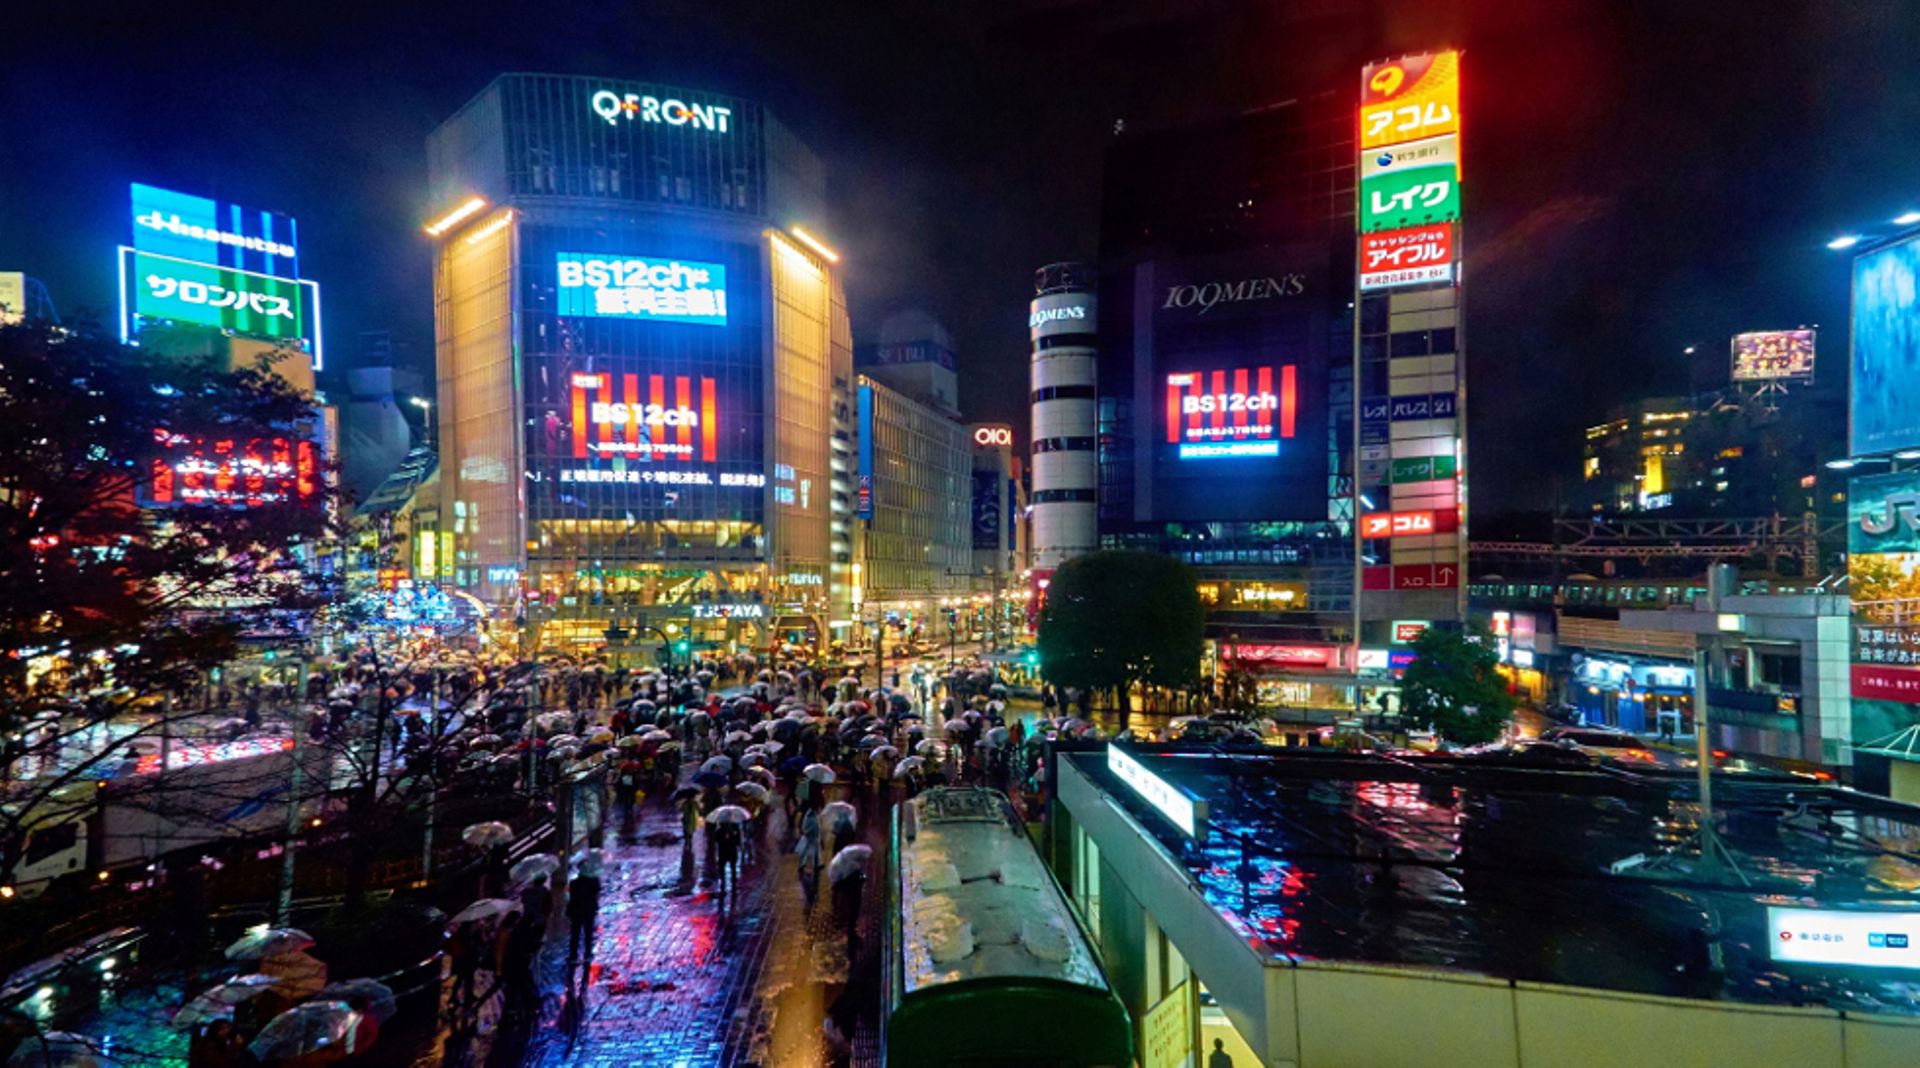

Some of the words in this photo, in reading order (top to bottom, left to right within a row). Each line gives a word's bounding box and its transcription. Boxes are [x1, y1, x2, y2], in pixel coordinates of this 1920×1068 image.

[1367, 101, 1453, 136] アコム
[1371, 180, 1449, 214] レイク
[136, 210, 296, 258] Hisamitsu
[1367, 242, 1447, 269] アイフル
[146, 273, 295, 320] サロンパス
[591, 402, 698, 428] BS12ch
[1182, 391, 1278, 415] BS12ch
[1369, 514, 1431, 534] アコム
[1401, 576, 1425, 587] 入口
